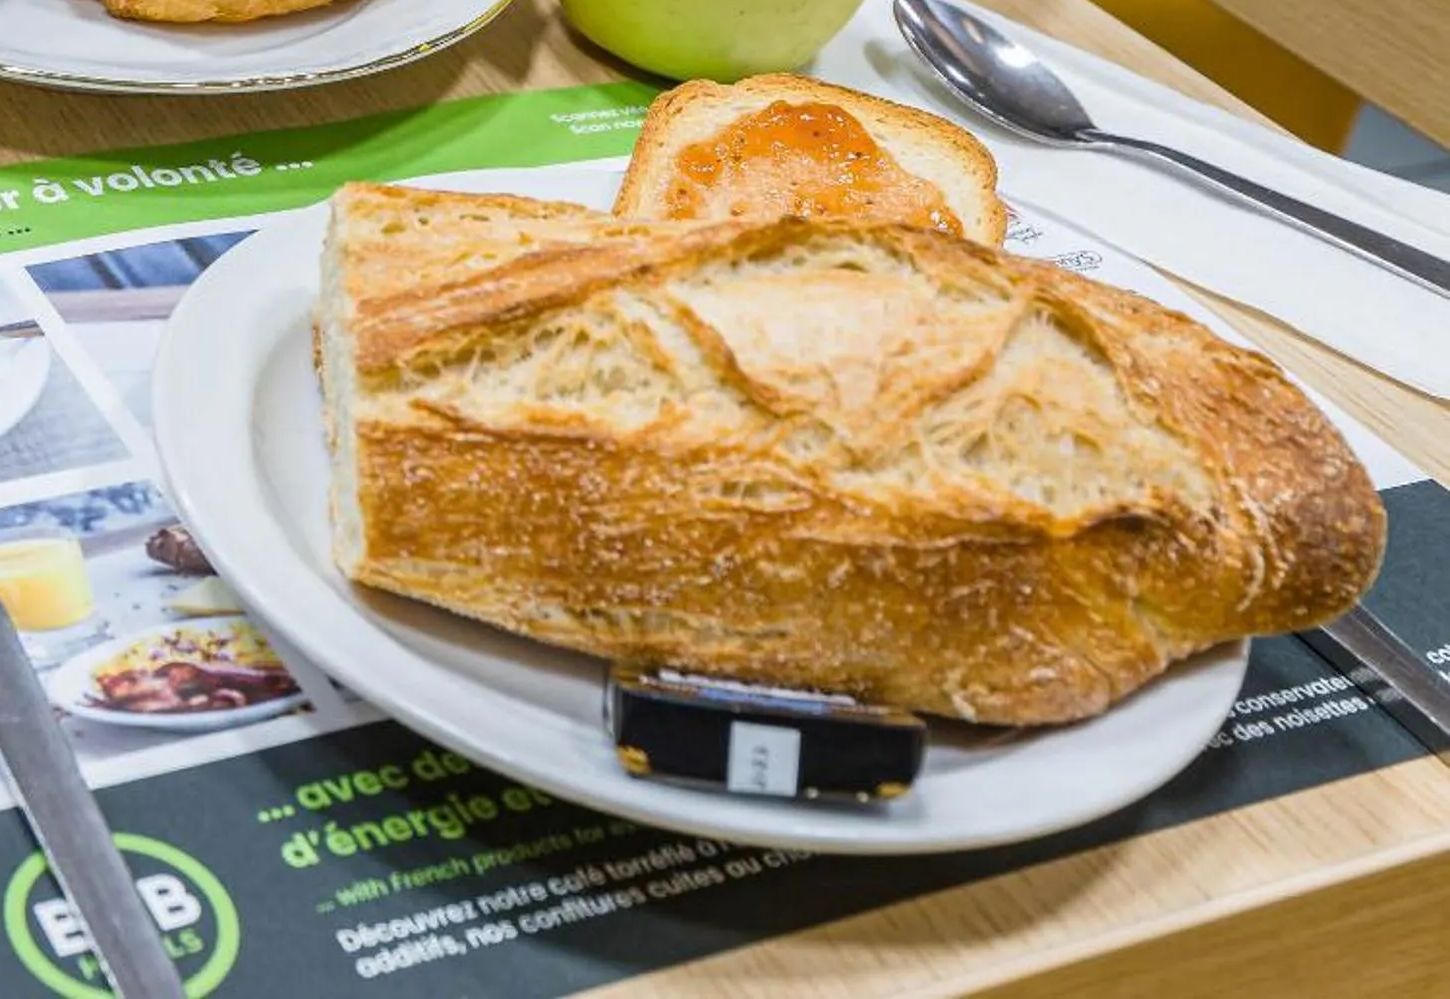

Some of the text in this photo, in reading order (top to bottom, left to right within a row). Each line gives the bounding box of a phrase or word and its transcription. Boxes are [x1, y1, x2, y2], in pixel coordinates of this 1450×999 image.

[32, 177, 70, 204] à
[72, 150, 262, 197] volonté
[1233, 719, 1276, 742] des
[1273, 697, 1369, 732] noisettes
[280, 793, 499, 869] d'énergie
[32, 873, 203, 958] BB
[336, 900, 479, 953] Découvrez
[476, 881, 548, 916] notre
[547, 863, 605, 896] café
[354, 932, 468, 979] additifs,
[464, 919, 519, 950] nos
[518, 884, 647, 935] confitures
[647, 865, 726, 900] cuites
[725, 855, 763, 879] au
